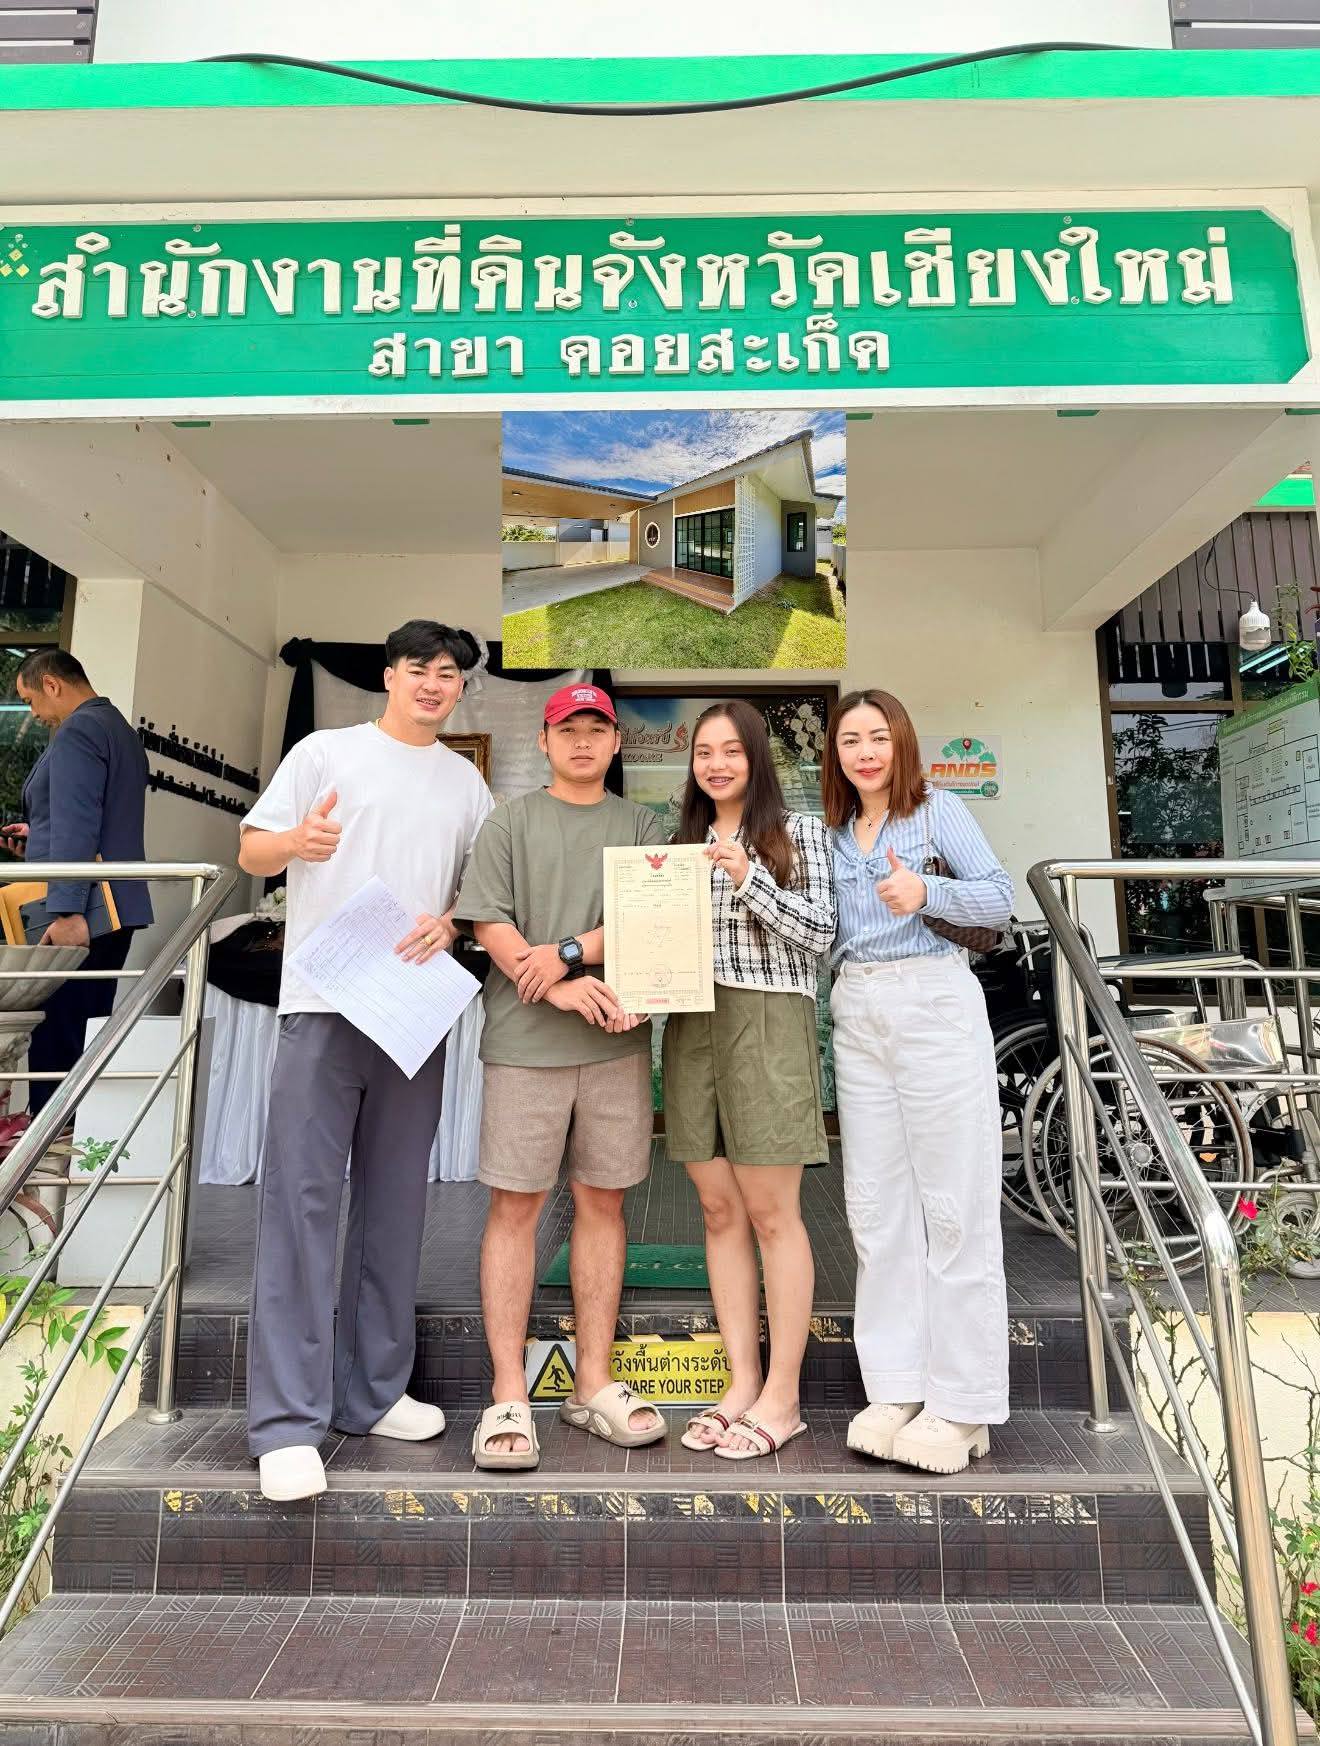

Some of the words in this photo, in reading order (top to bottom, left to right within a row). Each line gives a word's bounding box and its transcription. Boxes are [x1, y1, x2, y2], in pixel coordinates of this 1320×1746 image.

[31, 223, 1234, 319] สำนักงานที่ดินจังหวัดเชียงใหม่
[368, 332, 524, 377] สาขา
[560, 312, 890, 377] ดอยสะเก็ด
[920, 763, 997, 779] ANDS
[611, 1343, 732, 1372] วังพื้นต่างระดับ
[660, 1379, 691, 1394] YOUR
[695, 1379, 724, 1394] STEP
